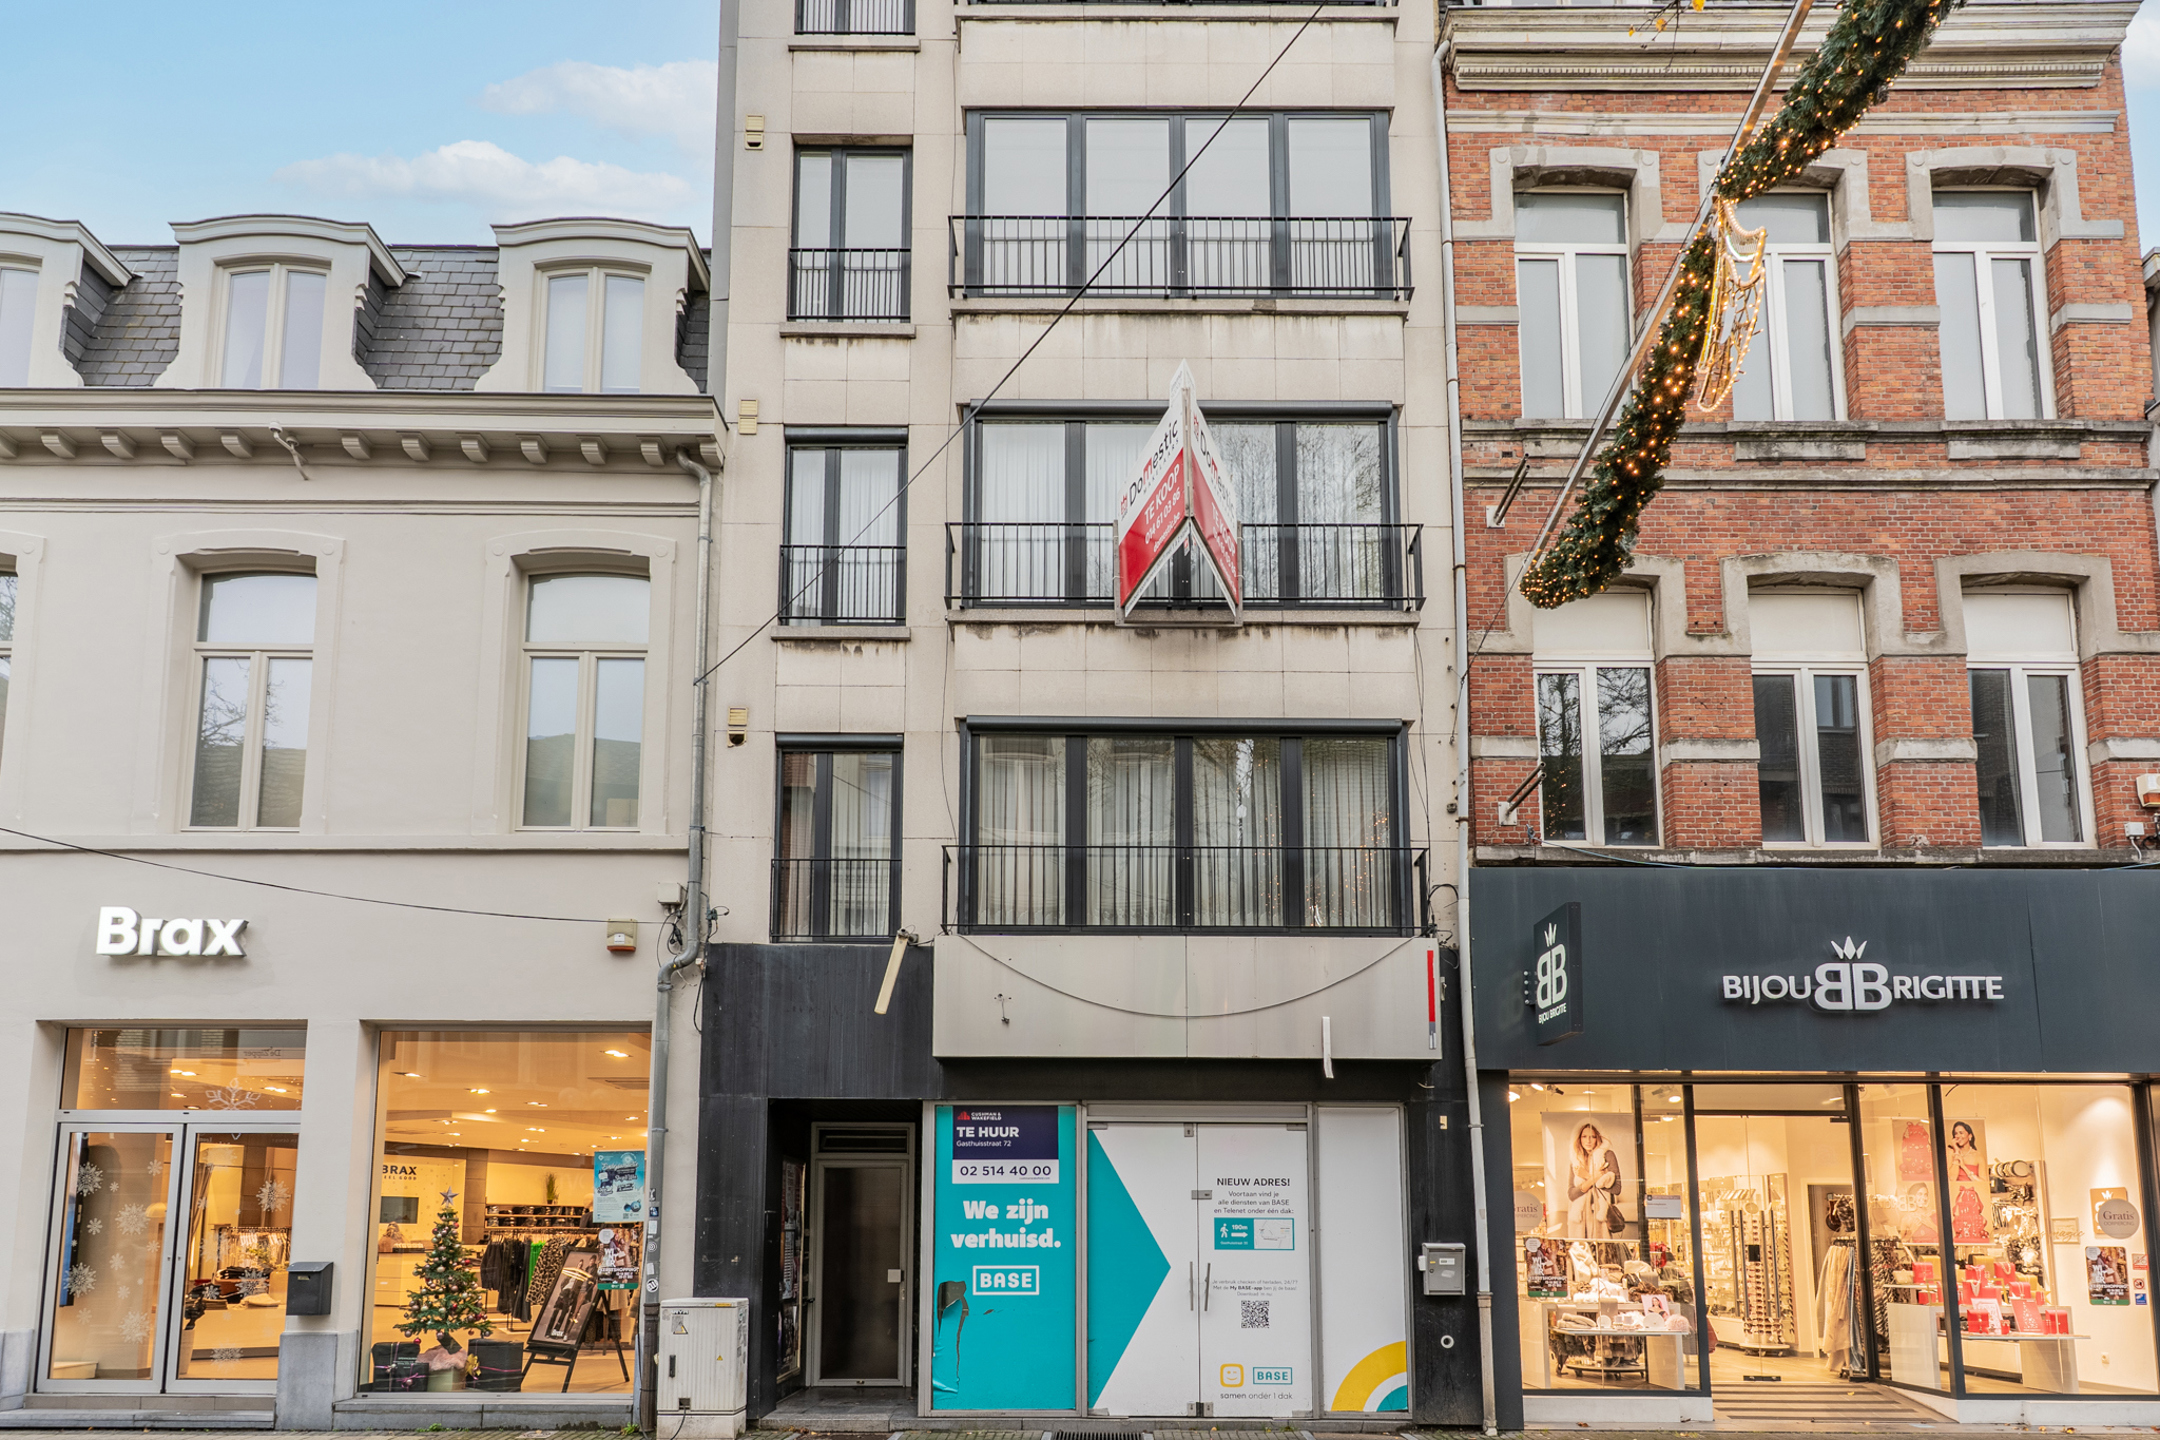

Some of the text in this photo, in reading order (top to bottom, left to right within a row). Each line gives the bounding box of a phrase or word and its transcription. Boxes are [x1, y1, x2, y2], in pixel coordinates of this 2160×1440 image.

[1129, 420, 1178, 506] Domestic
[1144, 463, 1180, 525] TE KOOP
[1144, 523, 1156, 545] 014
[1153, 511, 1181, 553] domestic.be
[96, 906, 247, 956] Brax
[1722, 975, 1812, 1005] BIJOU
[1538, 1010, 1550, 1025] BIJOU
[956, 1127, 1020, 1138] TE HUUR
[960, 1166, 1052, 1176] 02 514 40 00
[1216, 1178, 1291, 1187] NIEUW ADRES!
[963, 1198, 1049, 1225] We zijn
[1515, 1203, 1539, 1213] ratis
[2102, 1210, 2135, 1220] Gratis
[950, 1226, 1062, 1248] verhuisd.
[980, 1272, 1032, 1288] BASE
[1257, 1371, 1289, 1381] BASE
[1248, 1392, 1272, 1400] onder
[1277, 1392, 1293, 1400] dak
